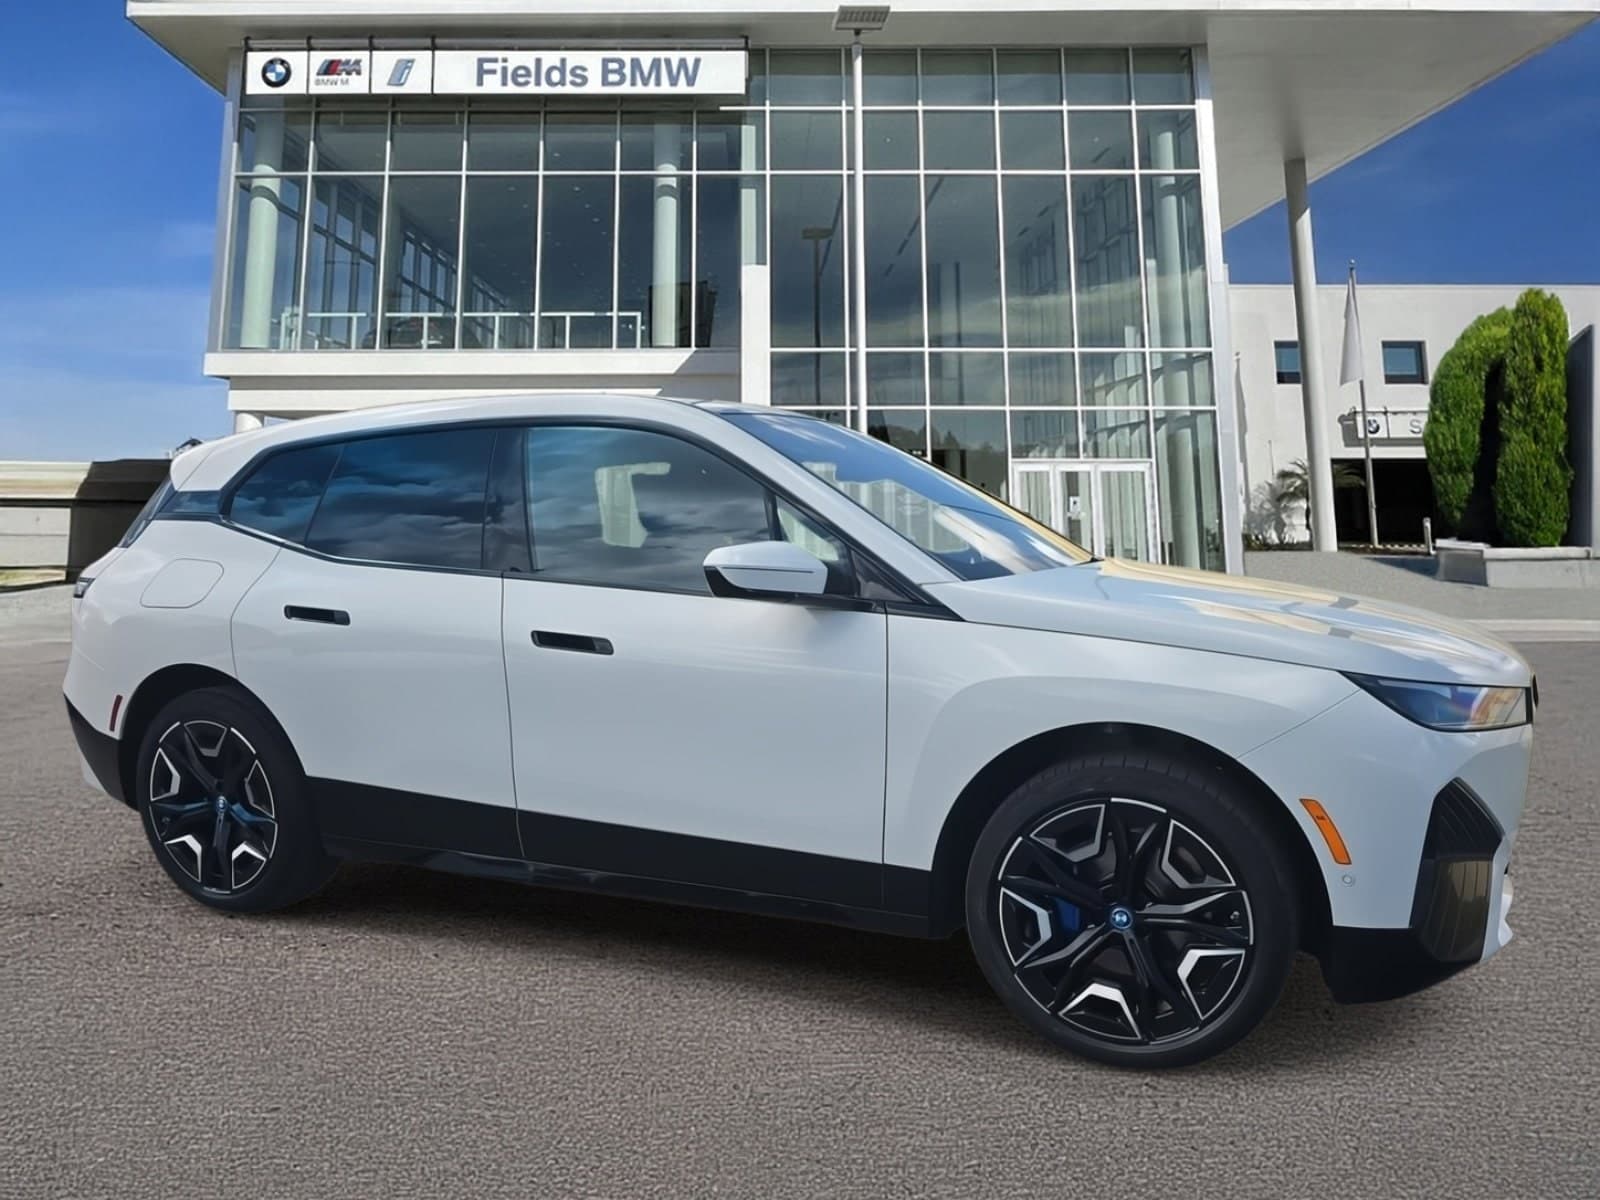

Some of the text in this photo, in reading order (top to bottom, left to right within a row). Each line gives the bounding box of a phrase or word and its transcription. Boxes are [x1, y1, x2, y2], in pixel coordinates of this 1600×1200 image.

[475, 57, 701, 87] Fields BMW
[315, 78, 350, 86] BMW M
